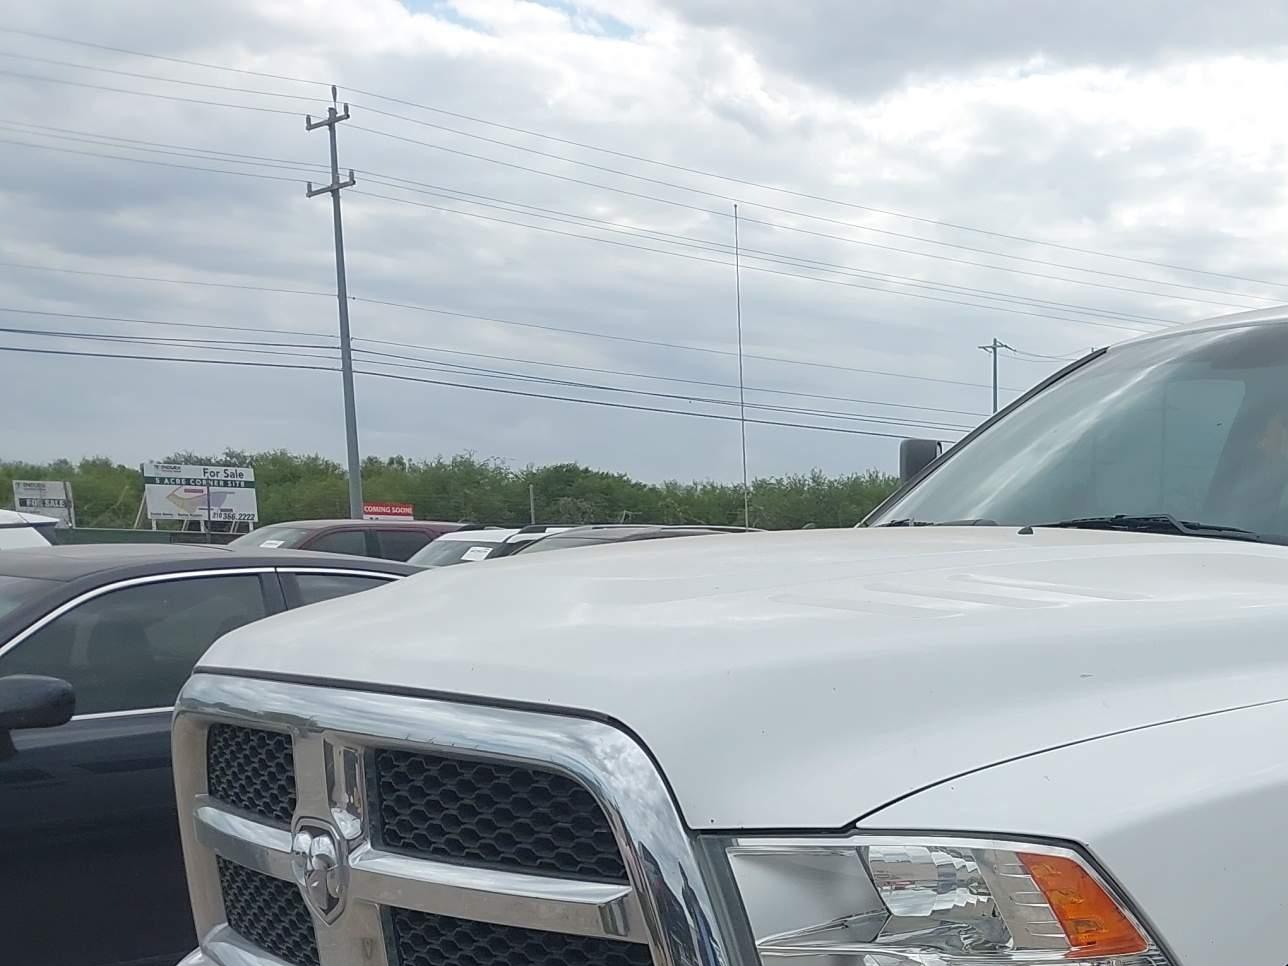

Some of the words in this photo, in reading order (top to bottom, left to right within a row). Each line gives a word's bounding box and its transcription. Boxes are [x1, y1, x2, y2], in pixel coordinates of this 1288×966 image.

[203, 468, 220, 478] For
[223, 469, 244, 479] Sale
[190, 479, 224, 487] CORNER
[363, 505, 391, 513] COMING
